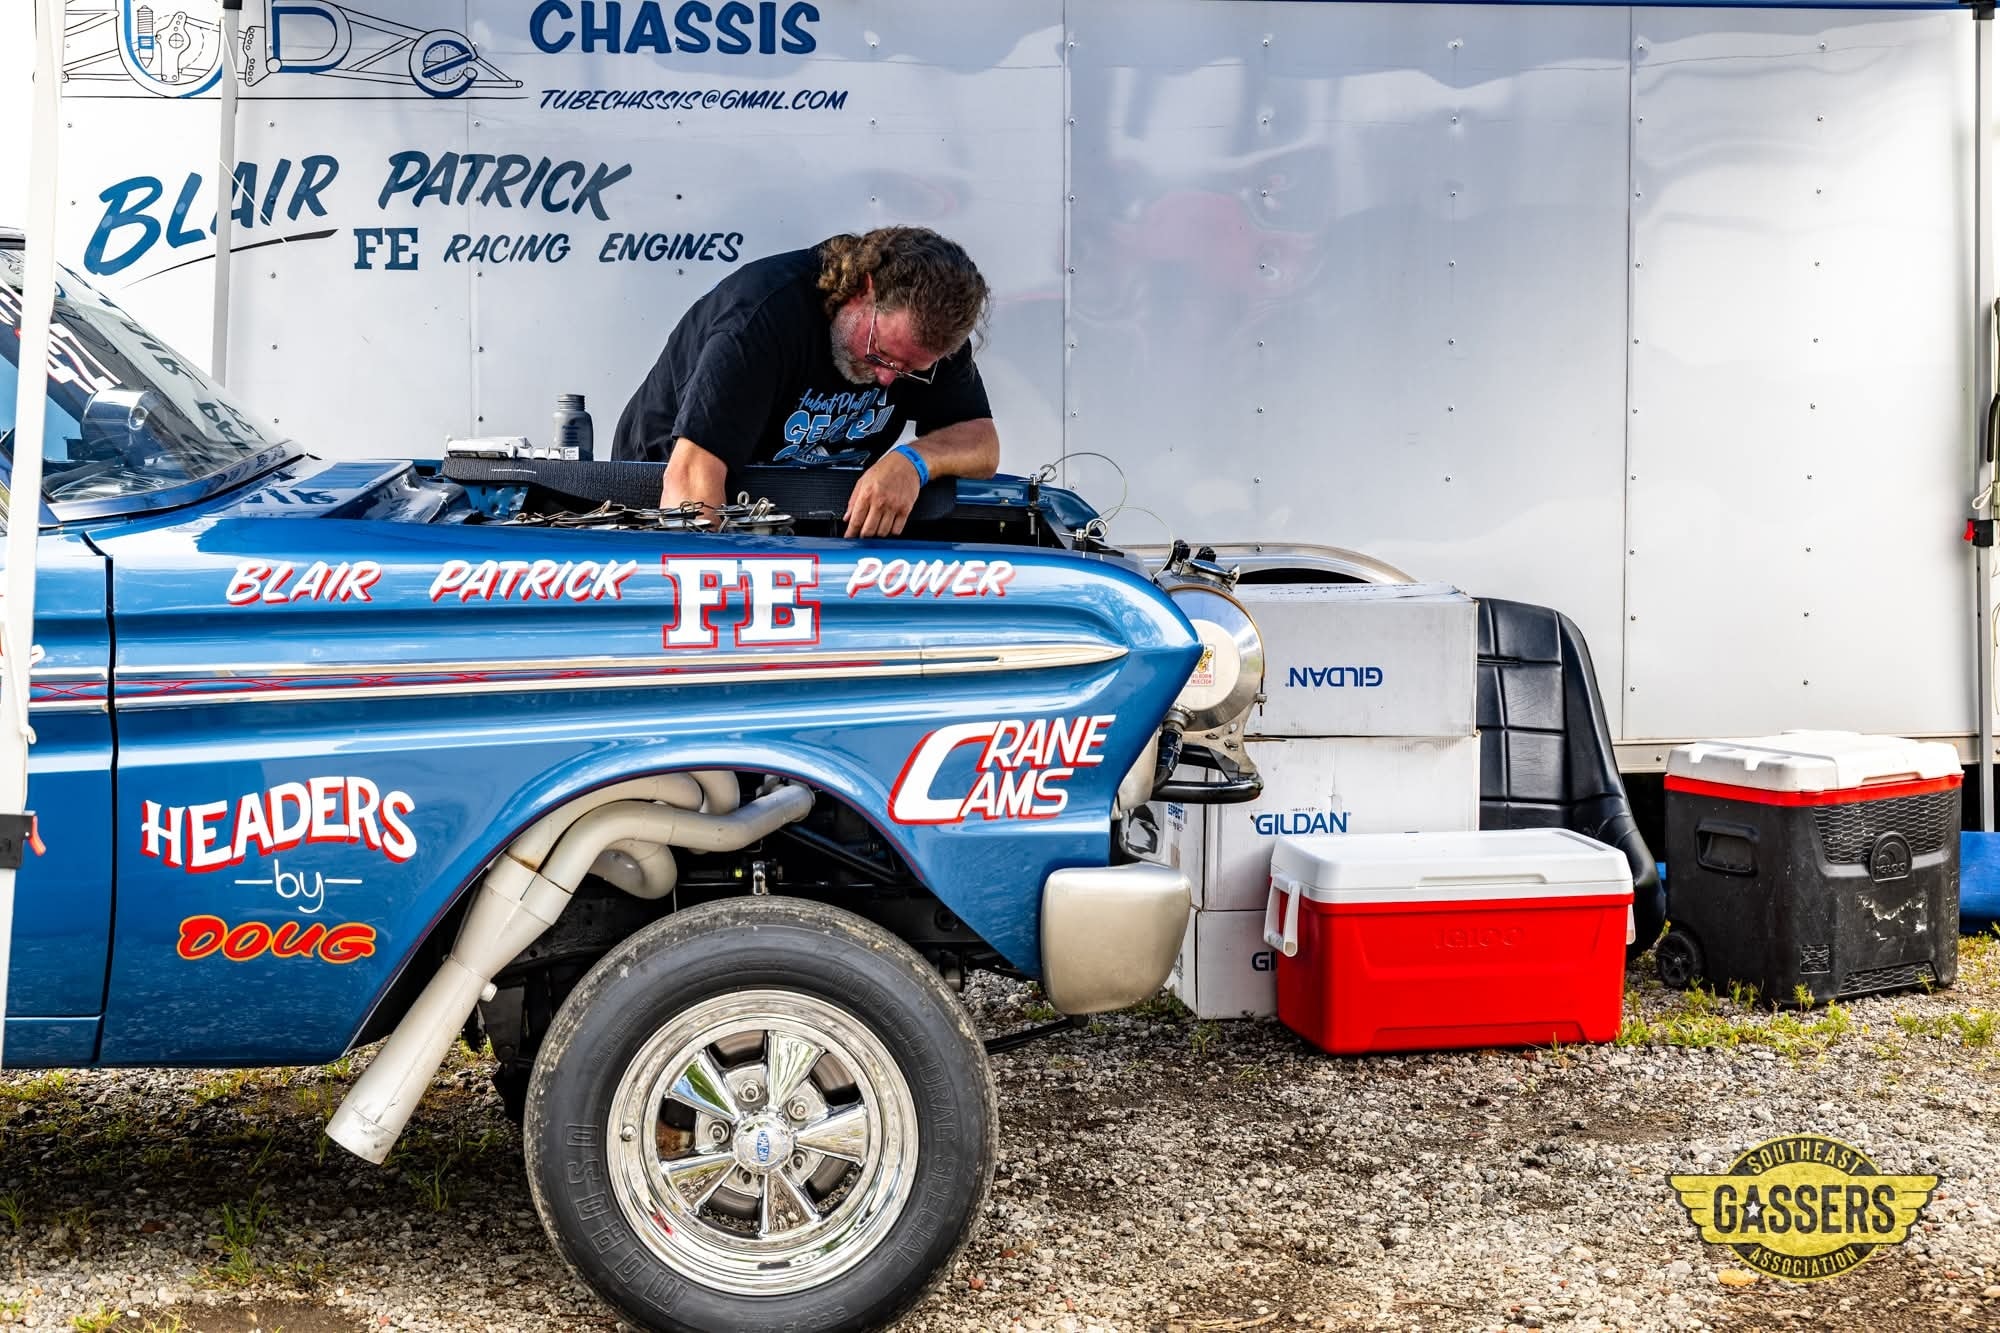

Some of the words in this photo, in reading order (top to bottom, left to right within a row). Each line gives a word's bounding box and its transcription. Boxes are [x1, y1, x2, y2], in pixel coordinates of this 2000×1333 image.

[529, 0, 820, 55] CHASSIS
[540, 89, 849, 111] TUBECHASSIS@GMAIL.COM
[84, 154, 340, 276] BLAIR
[377, 151, 633, 221] PATRICK
[353, 227, 419, 271] FE
[443, 233, 571, 264] RACING
[599, 232, 744, 263] ENGINES
[225, 559, 382, 607] BLAIR
[428, 559, 637, 603] PATRICK
[662, 553, 821, 650] FE
[847, 557, 1016, 599] POWER
[1289, 666, 1383, 687] GILDAN
[888, 714, 1117, 824] CRANE
[140, 776, 417, 874] HEADERS
[1255, 812, 1348, 836] GILDAN
[177, 914, 377, 964] DOUG
[566, 1123, 689, 1314] MOROSO
